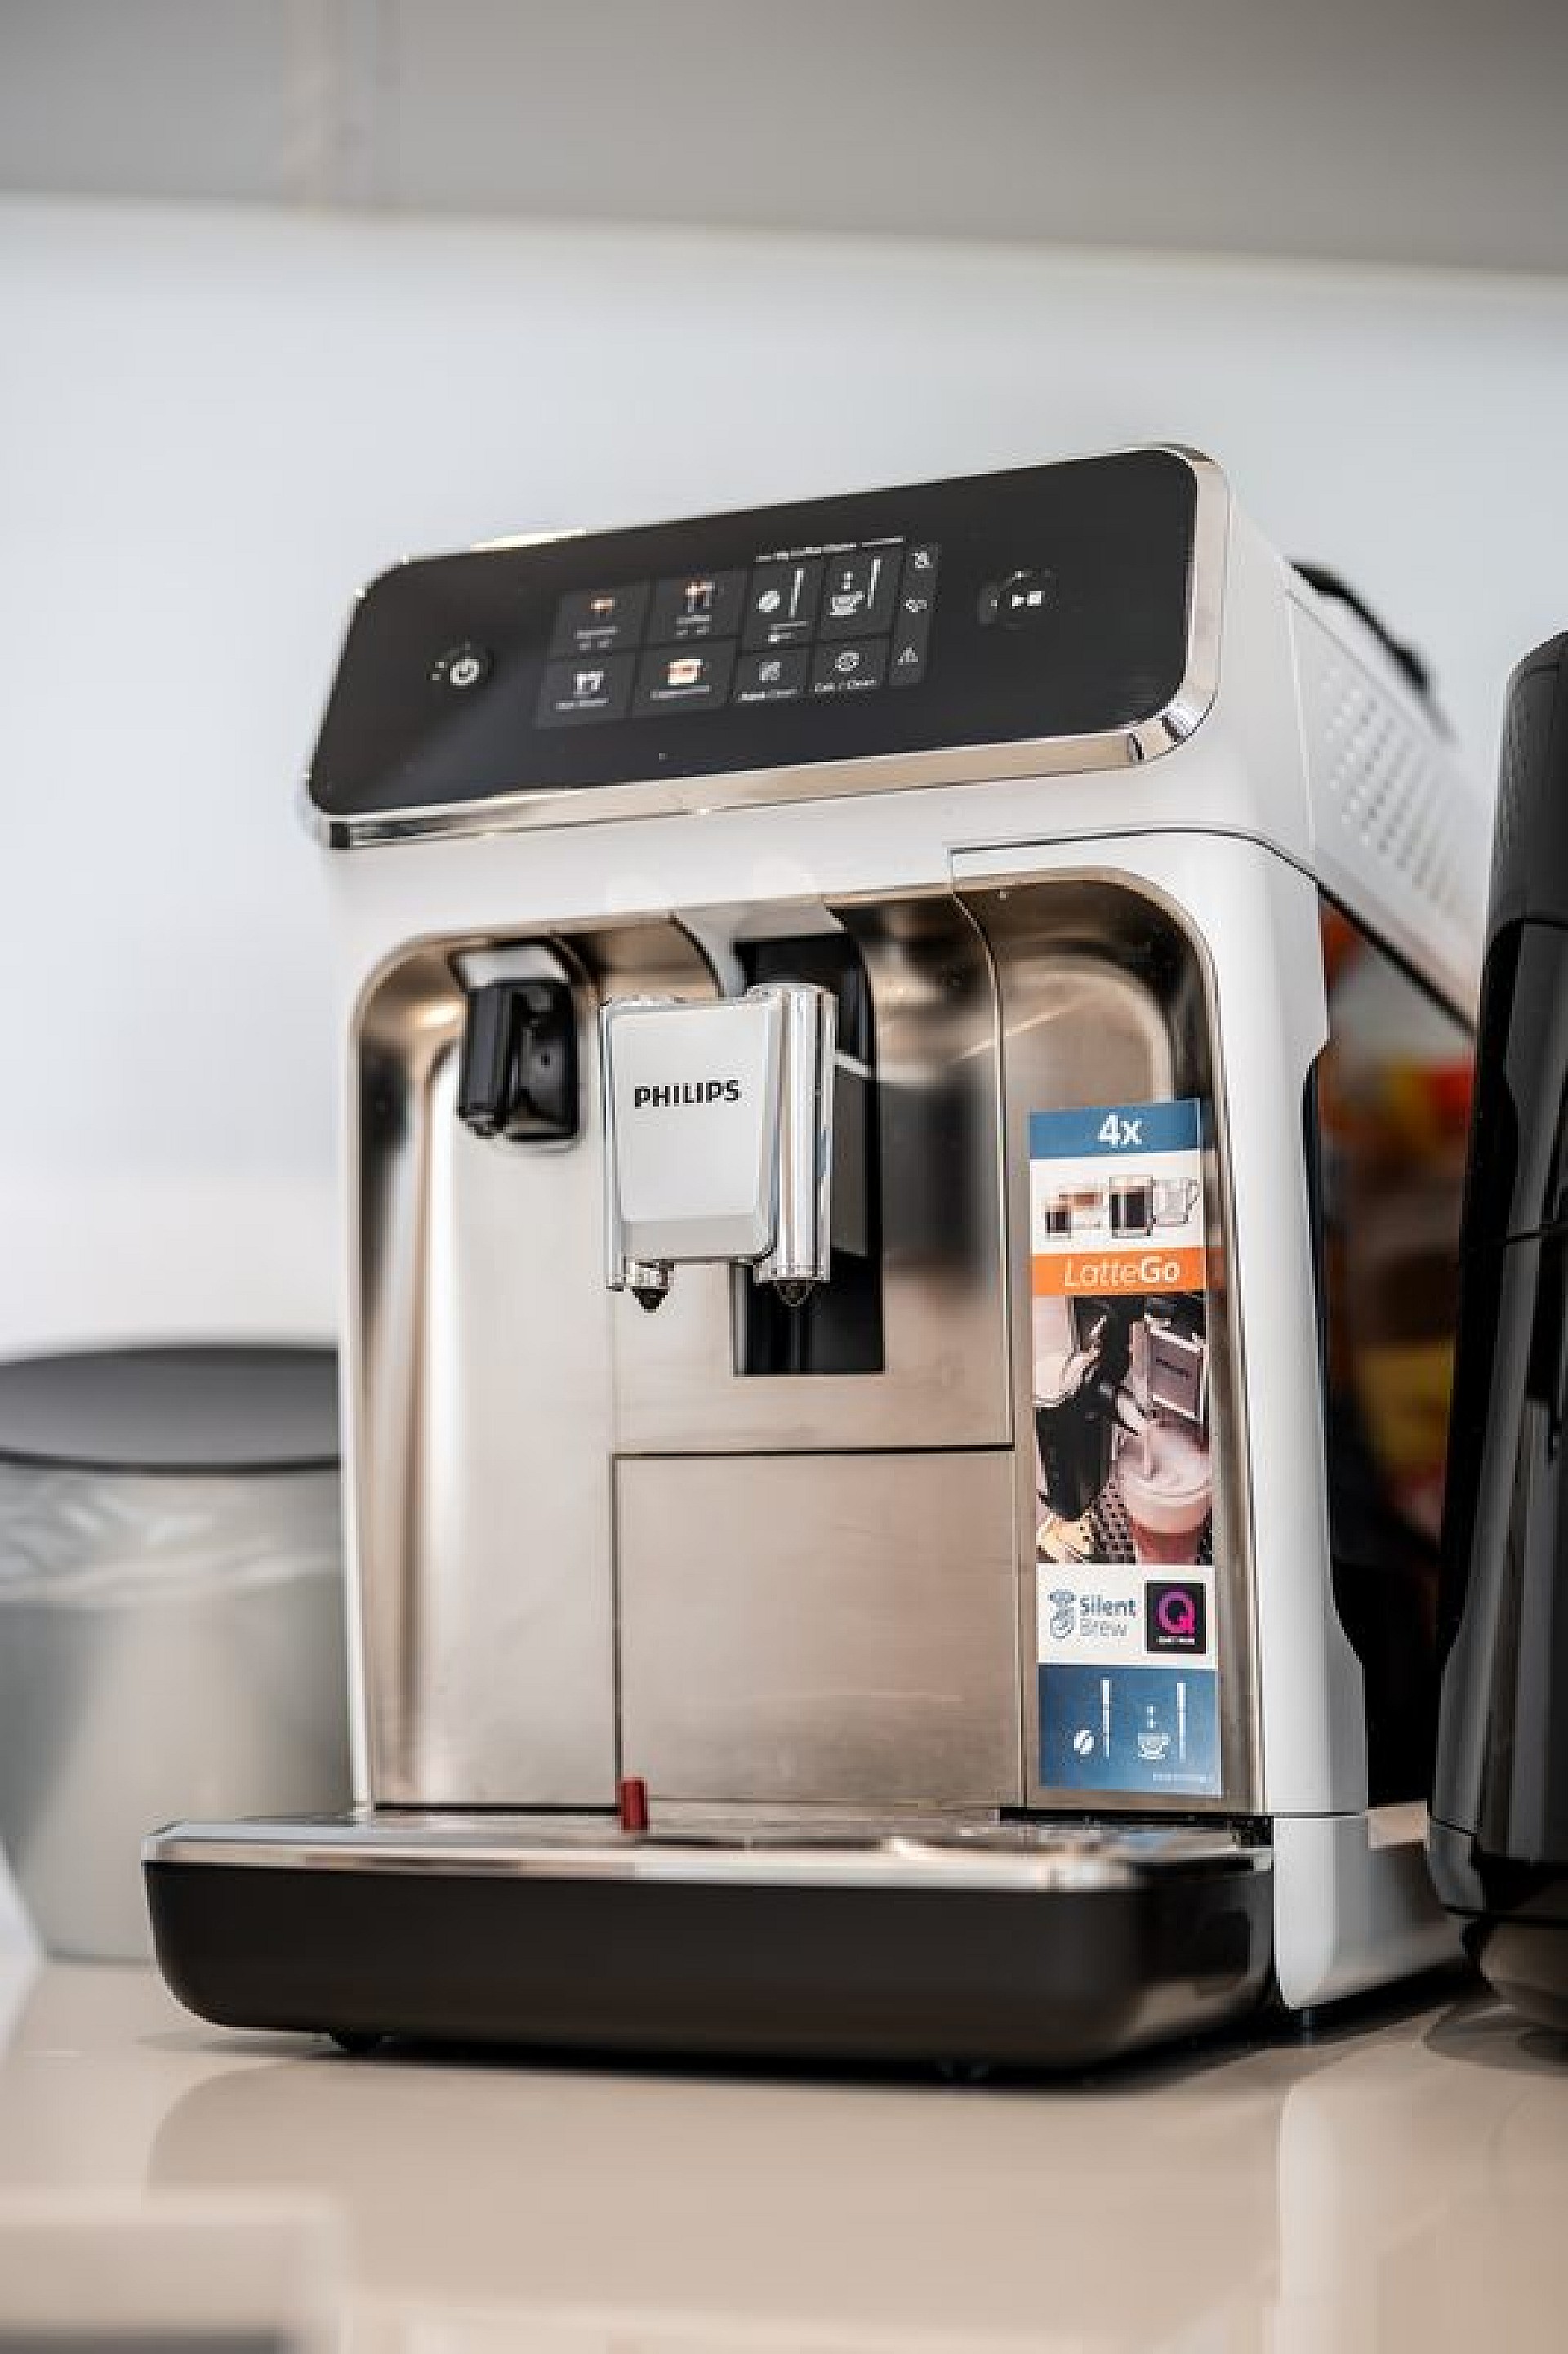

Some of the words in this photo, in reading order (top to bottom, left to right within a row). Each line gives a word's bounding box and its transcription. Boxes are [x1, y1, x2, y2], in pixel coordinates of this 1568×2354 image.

[635, 1079, 742, 1109] PHILIPS
[1097, 1114, 1143, 1148] 4x
[1064, 1255, 1181, 1286] LatteGo
[1079, 1594, 1136, 1617] Silent
[1079, 1618, 1129, 1637] Brew
